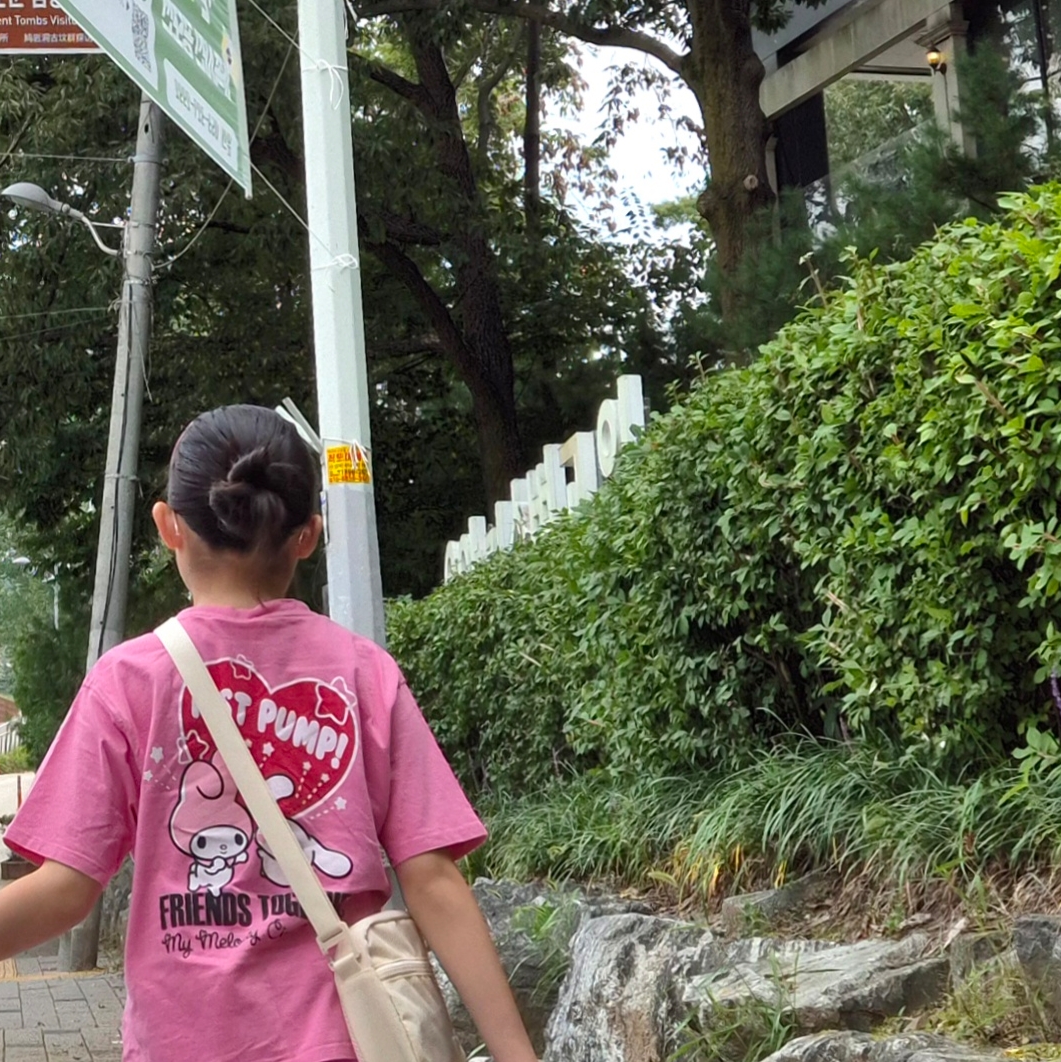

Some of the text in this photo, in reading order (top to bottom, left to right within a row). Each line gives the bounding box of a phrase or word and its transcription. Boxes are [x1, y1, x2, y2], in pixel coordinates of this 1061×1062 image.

[14, 14, 48, 26] Tombs
[257, 698, 349, 769] PUMP!
[159, 892, 252, 930] FRIENDS
[161, 933, 193, 958] My
